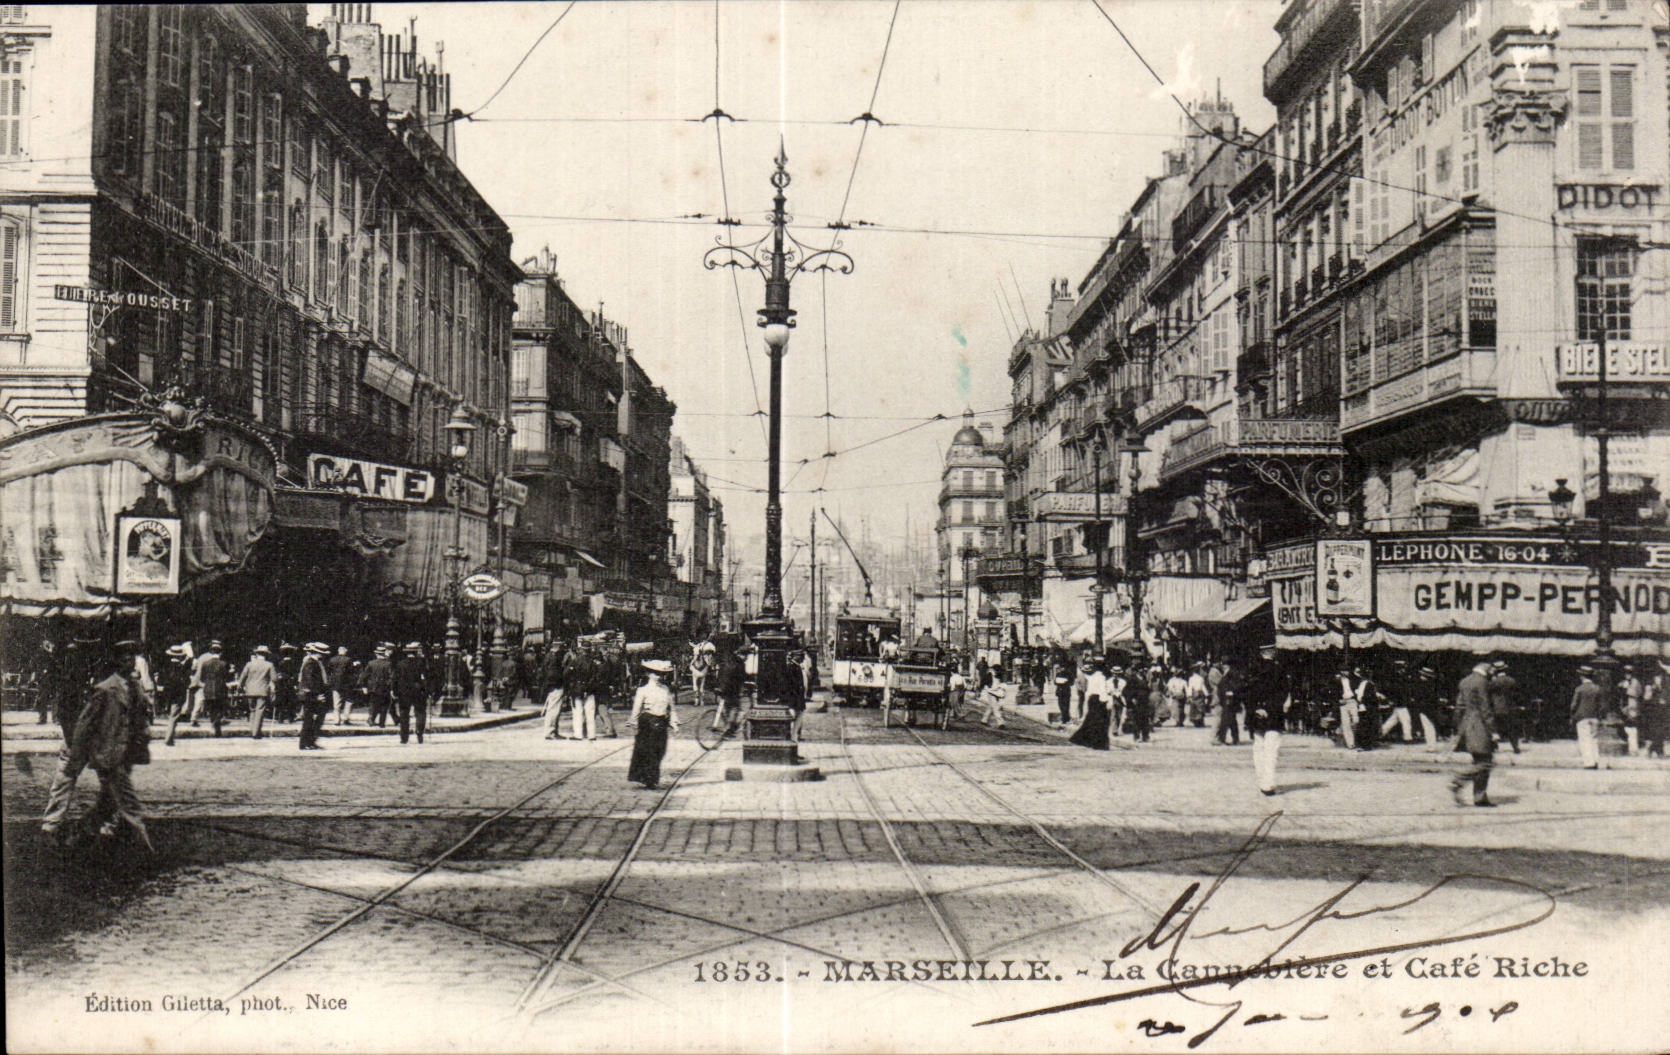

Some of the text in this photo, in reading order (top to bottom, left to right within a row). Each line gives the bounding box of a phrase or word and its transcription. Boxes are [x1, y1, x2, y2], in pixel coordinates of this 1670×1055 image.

[1558, 185, 1660, 211] DIDOT
[1565, 342, 1619, 375] BIEE
[1497, 546, 1551, 562] 16-04
